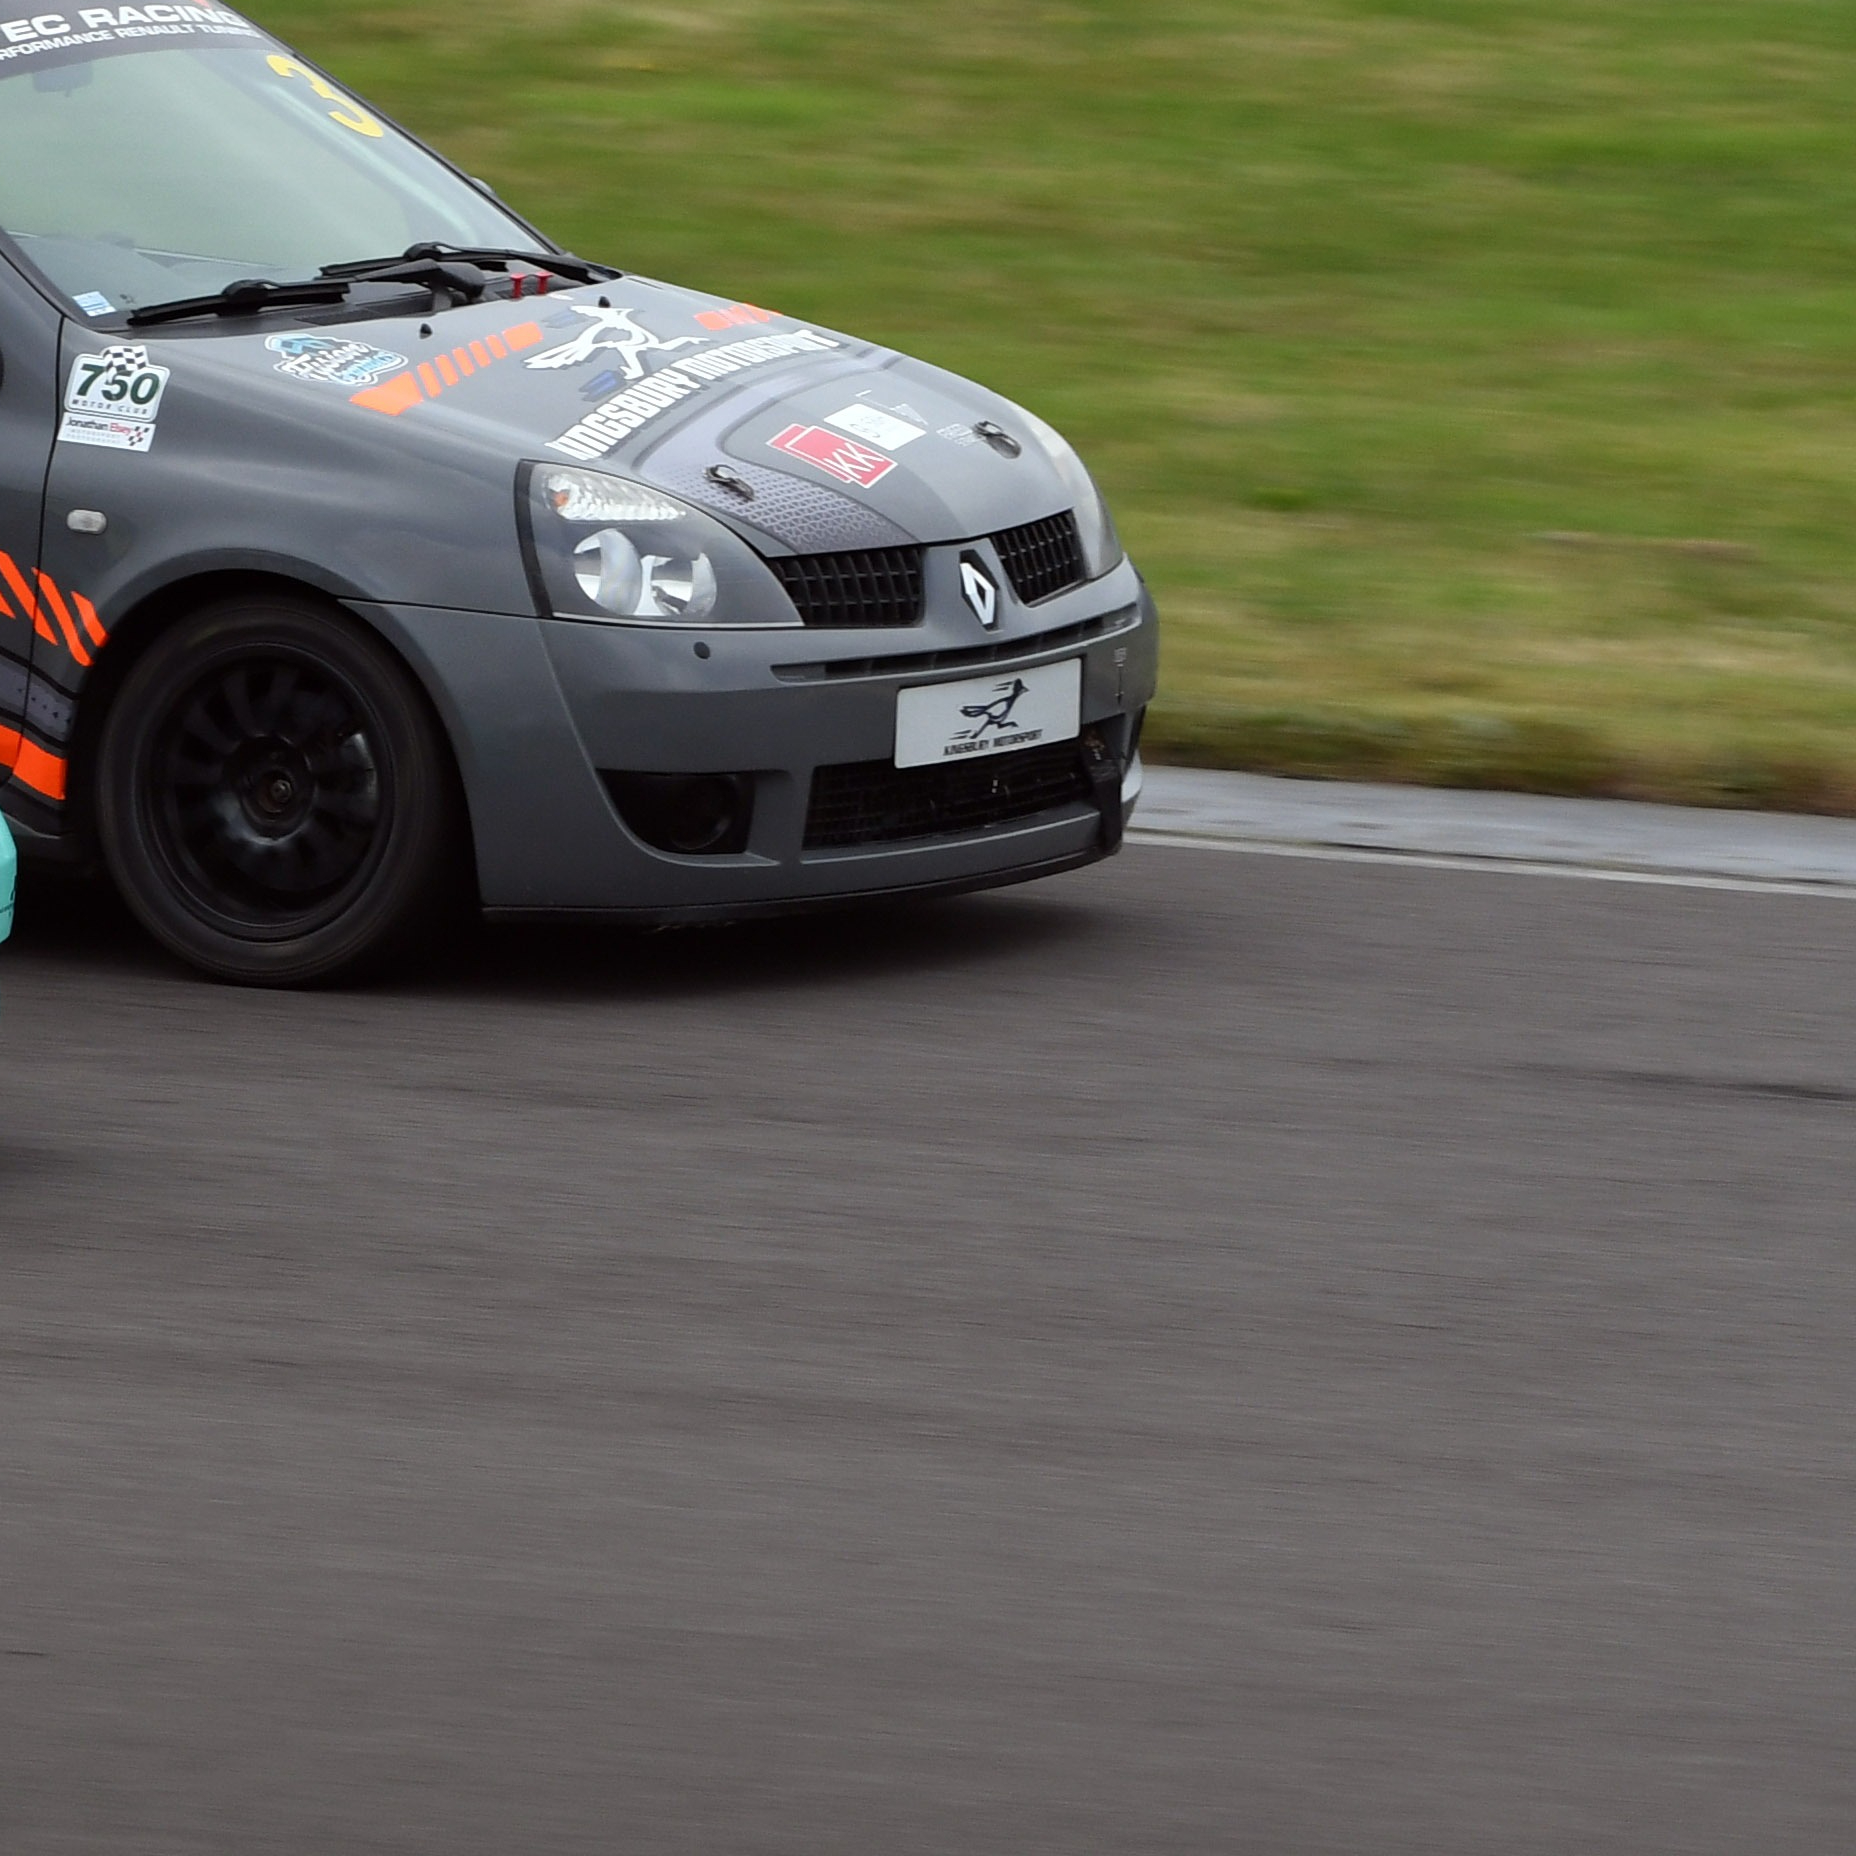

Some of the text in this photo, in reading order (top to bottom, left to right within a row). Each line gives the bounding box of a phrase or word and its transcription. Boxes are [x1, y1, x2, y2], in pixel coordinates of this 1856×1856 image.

[78, 4, 251, 29] RACING
[119, 23, 199, 40] RENAULT
[266, 54, 384, 138] 3
[671, 329, 840, 381] MOTORSPORT
[77, 363, 160, 405] 750
[72, 399, 147, 414] MOTOR CLUB
[66, 417, 108, 430] Jonathan
[823, 443, 885, 479] KK
